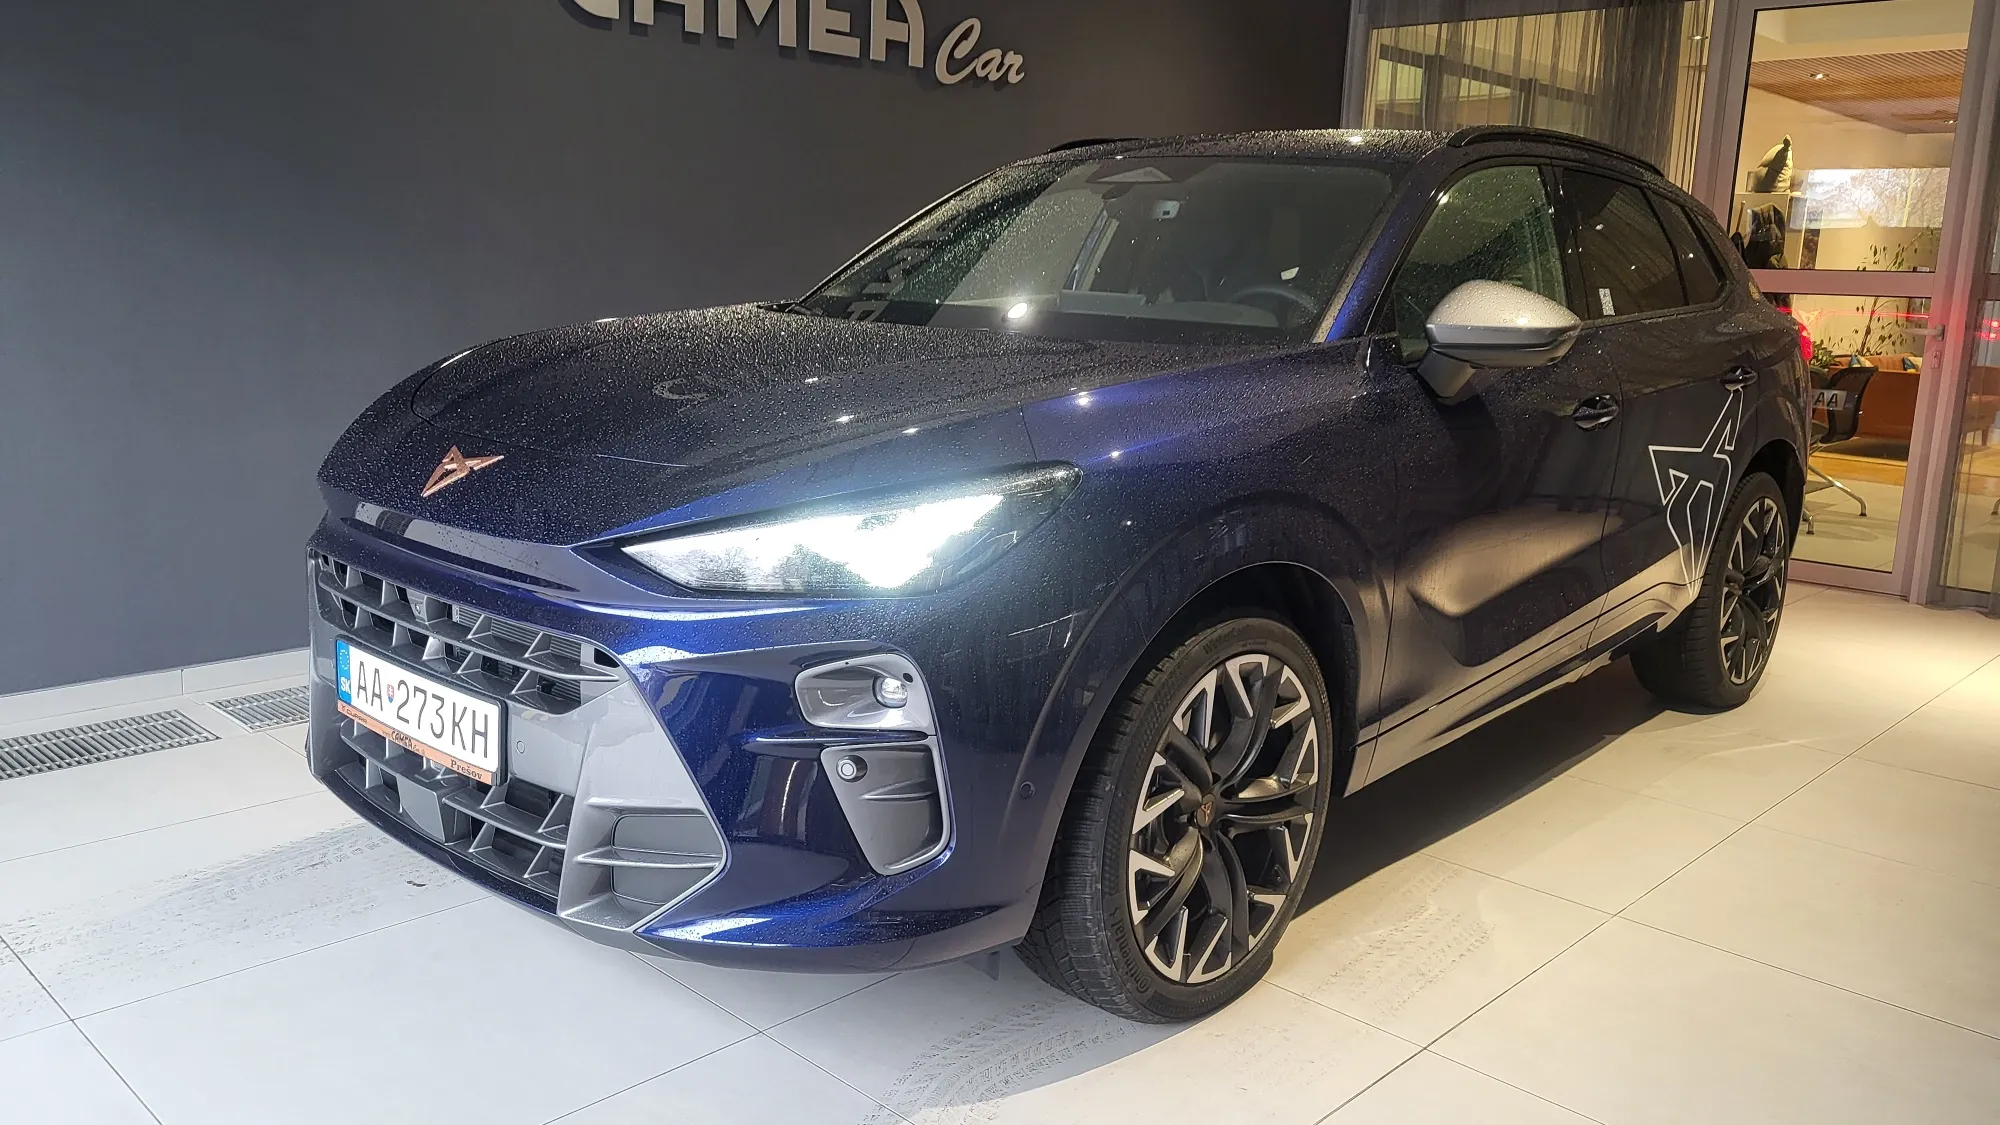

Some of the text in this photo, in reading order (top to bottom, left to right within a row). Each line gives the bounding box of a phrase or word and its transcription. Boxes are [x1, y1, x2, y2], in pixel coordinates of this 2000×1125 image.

[935, 17, 1025, 84] Car
[340, 677, 350, 695] SK
[450, 759, 482, 779] Prešov
